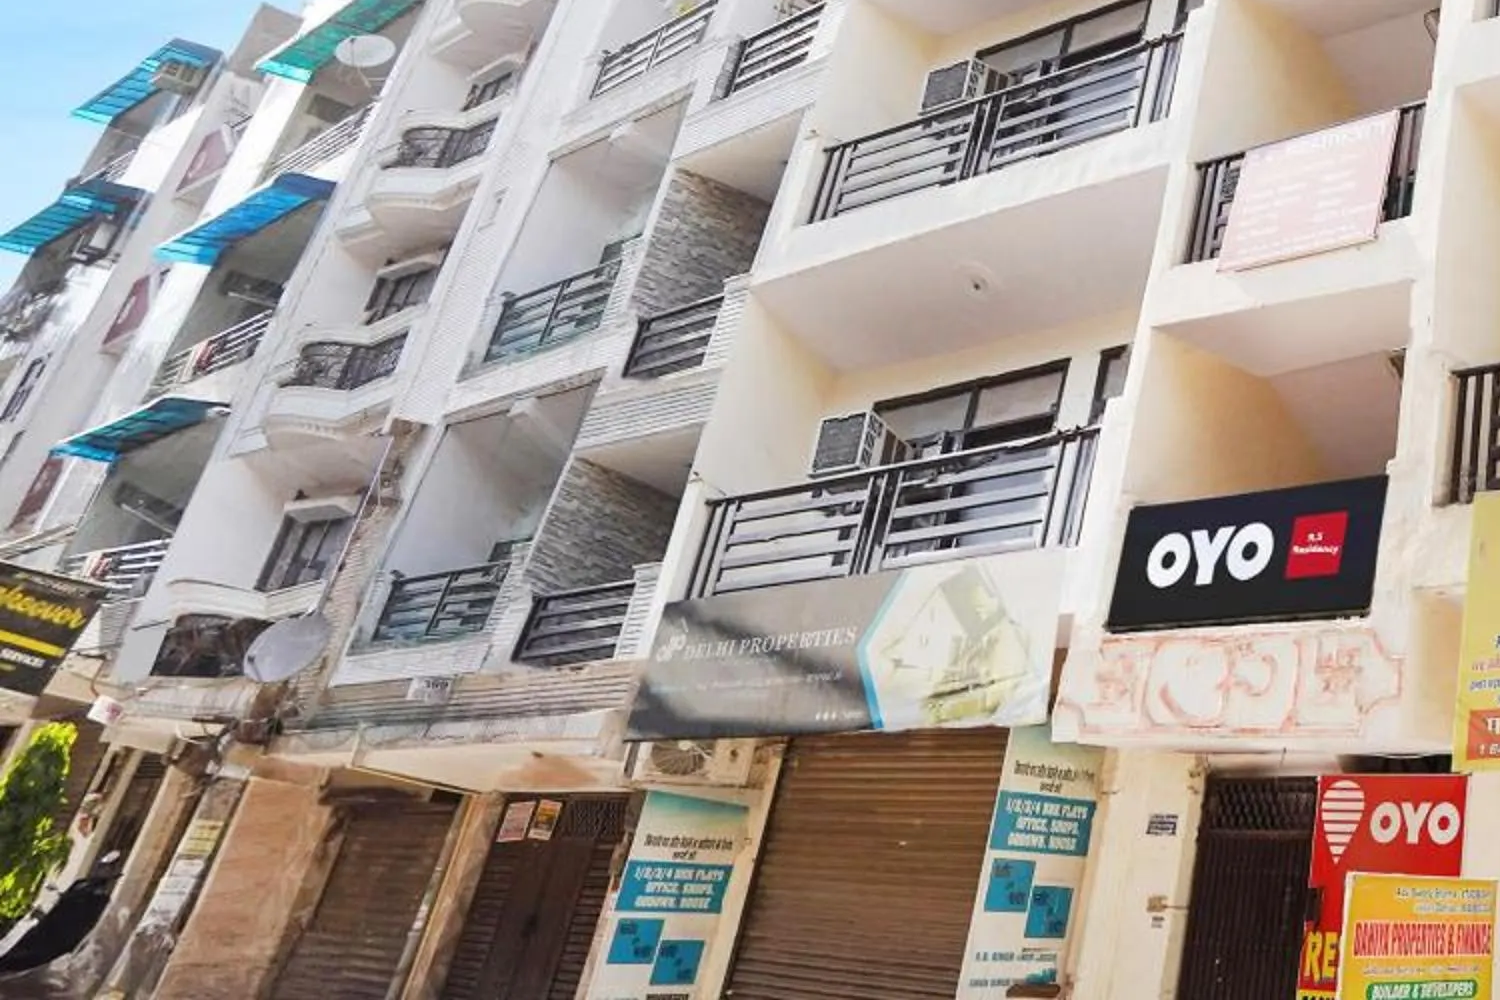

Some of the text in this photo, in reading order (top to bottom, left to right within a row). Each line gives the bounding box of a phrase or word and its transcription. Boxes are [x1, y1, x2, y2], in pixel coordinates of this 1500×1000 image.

[1147, 522, 1274, 588] OYO
[738, 626, 859, 654] PROPERTIES
[1370, 801, 1461, 845] OYO
